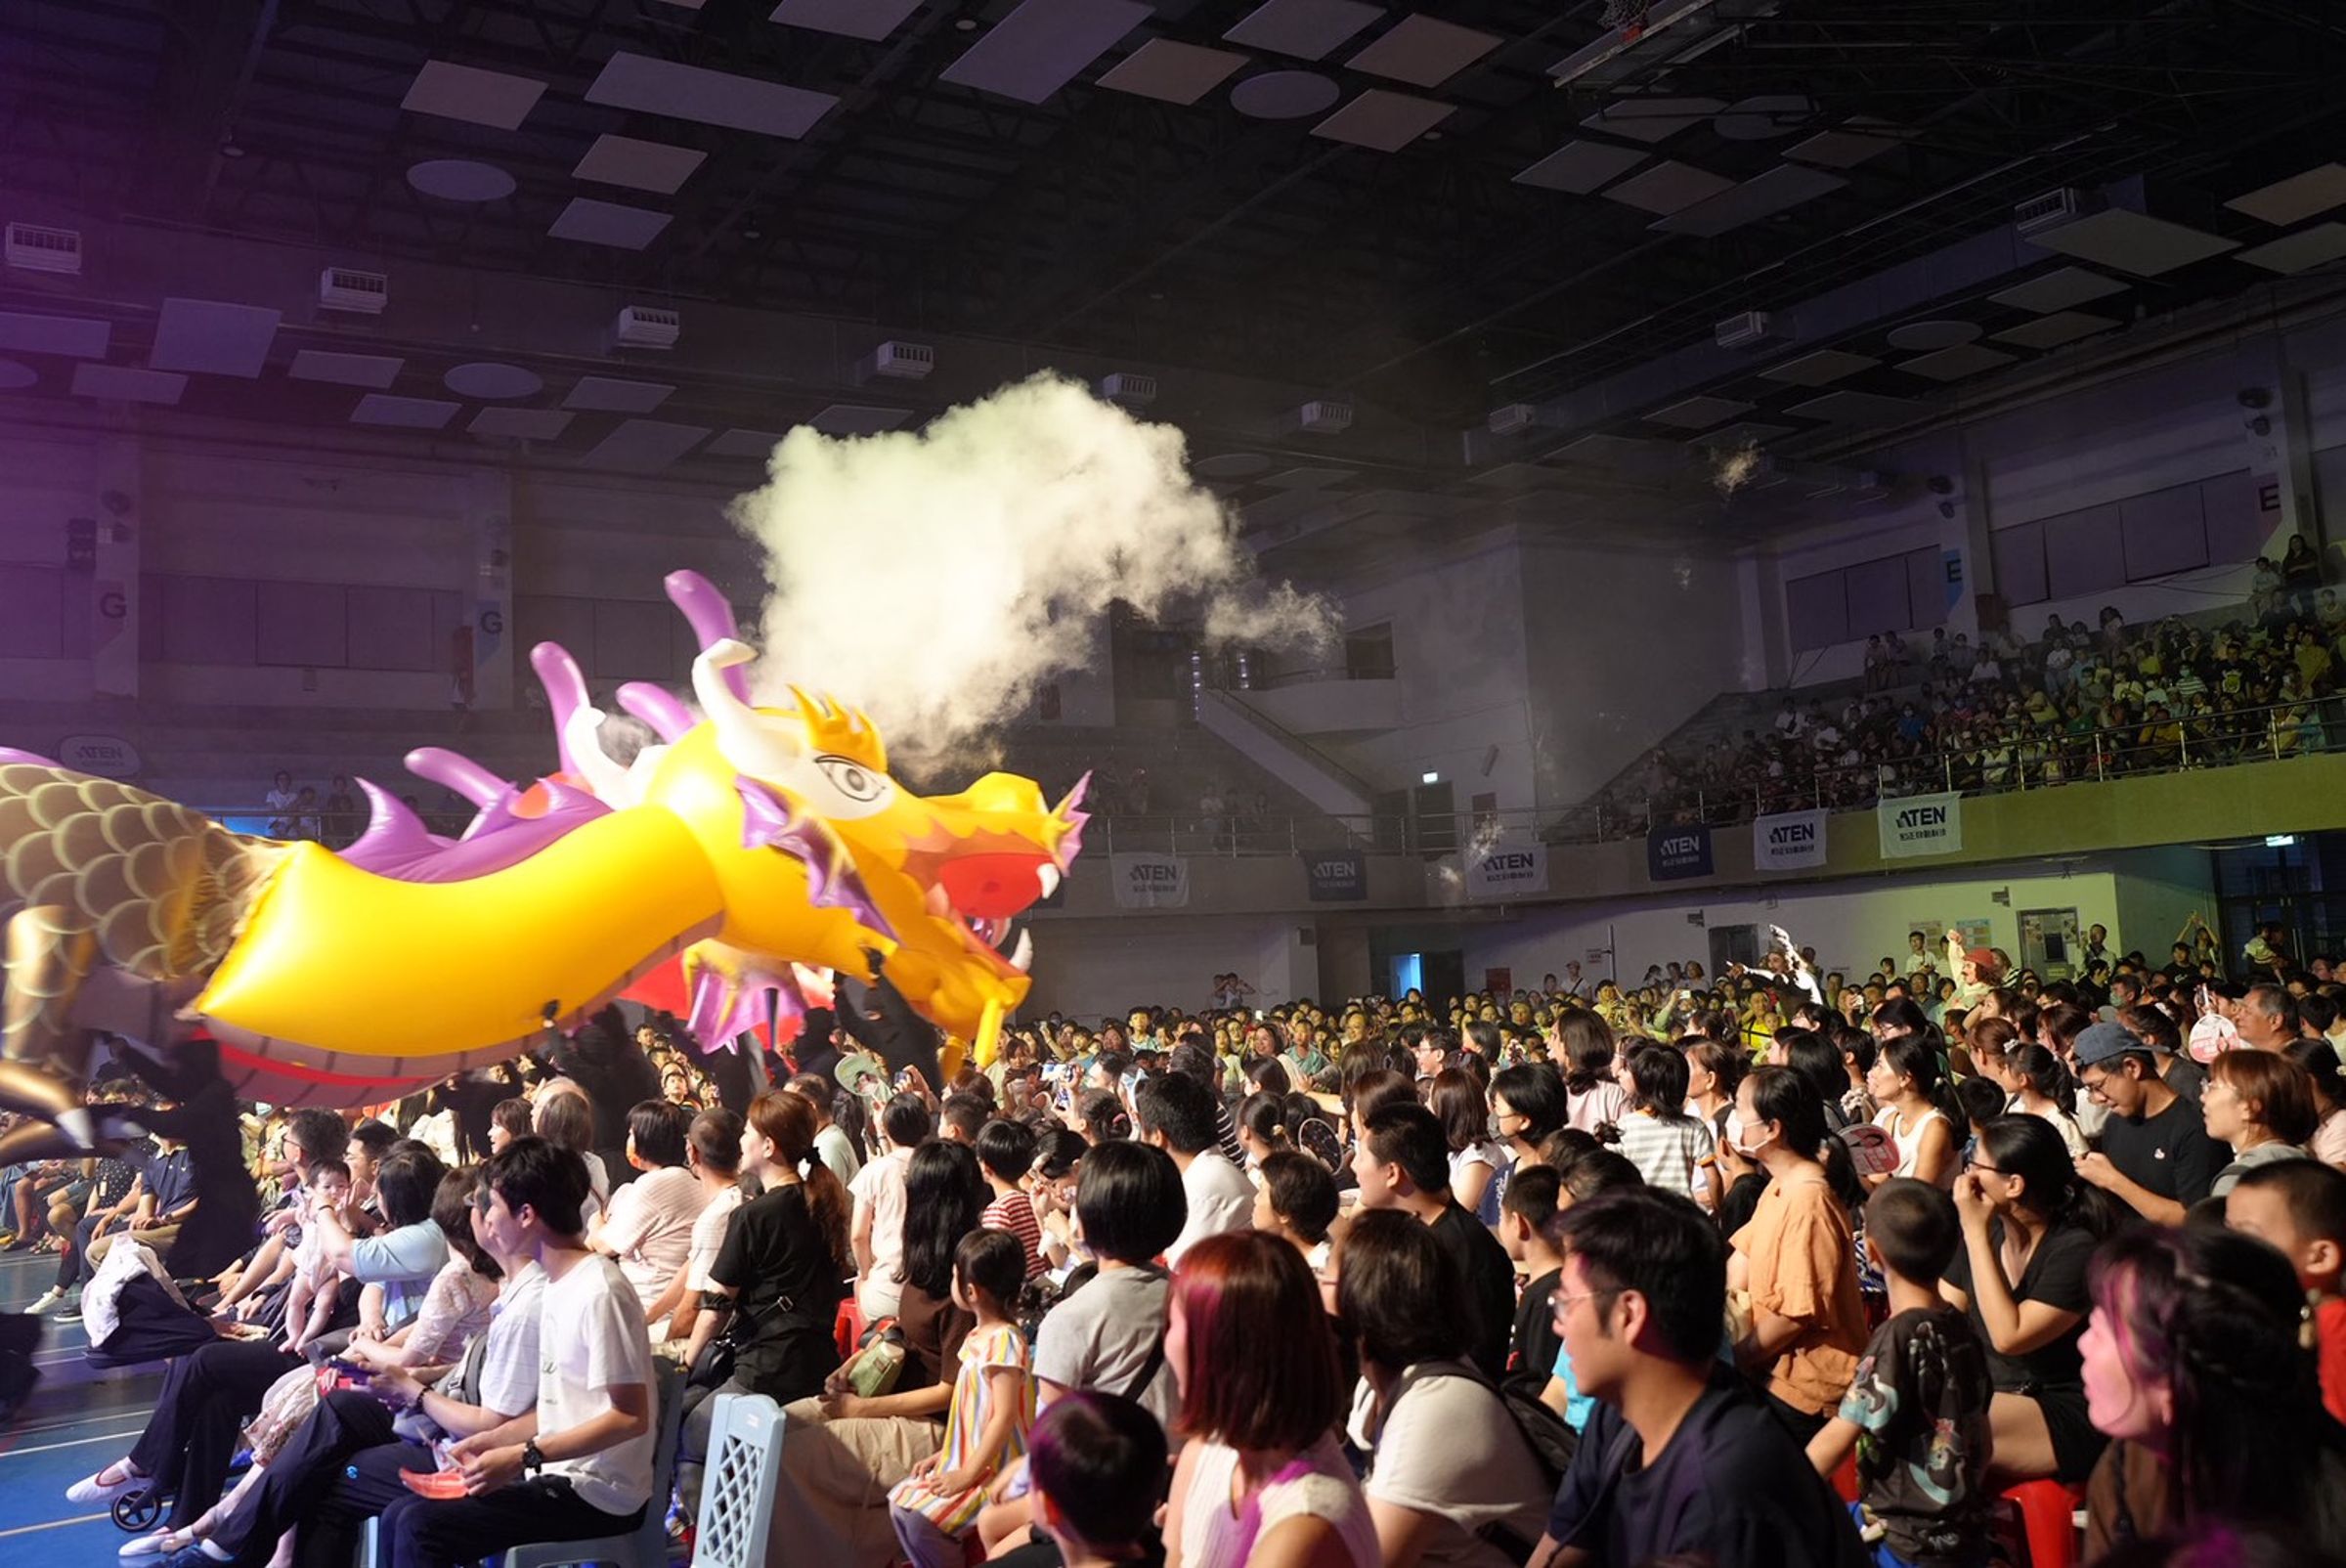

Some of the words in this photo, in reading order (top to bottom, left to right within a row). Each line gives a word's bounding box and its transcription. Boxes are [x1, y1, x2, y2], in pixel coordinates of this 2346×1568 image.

[2259, 483, 2281, 511] E
[1946, 559, 1963, 584] E
[100, 592, 127, 618] G
[480, 611, 502, 633] G
[75, 746, 123, 759] ATEN
[1895, 806, 1946, 828] ATEN
[1768, 823, 1814, 844] ATEN
[1660, 835, 1699, 855] ATEN
[1313, 861, 1355, 877] ATEN
[1483, 852, 1534, 871] ATEN
[1129, 864, 1177, 881] ATEN
